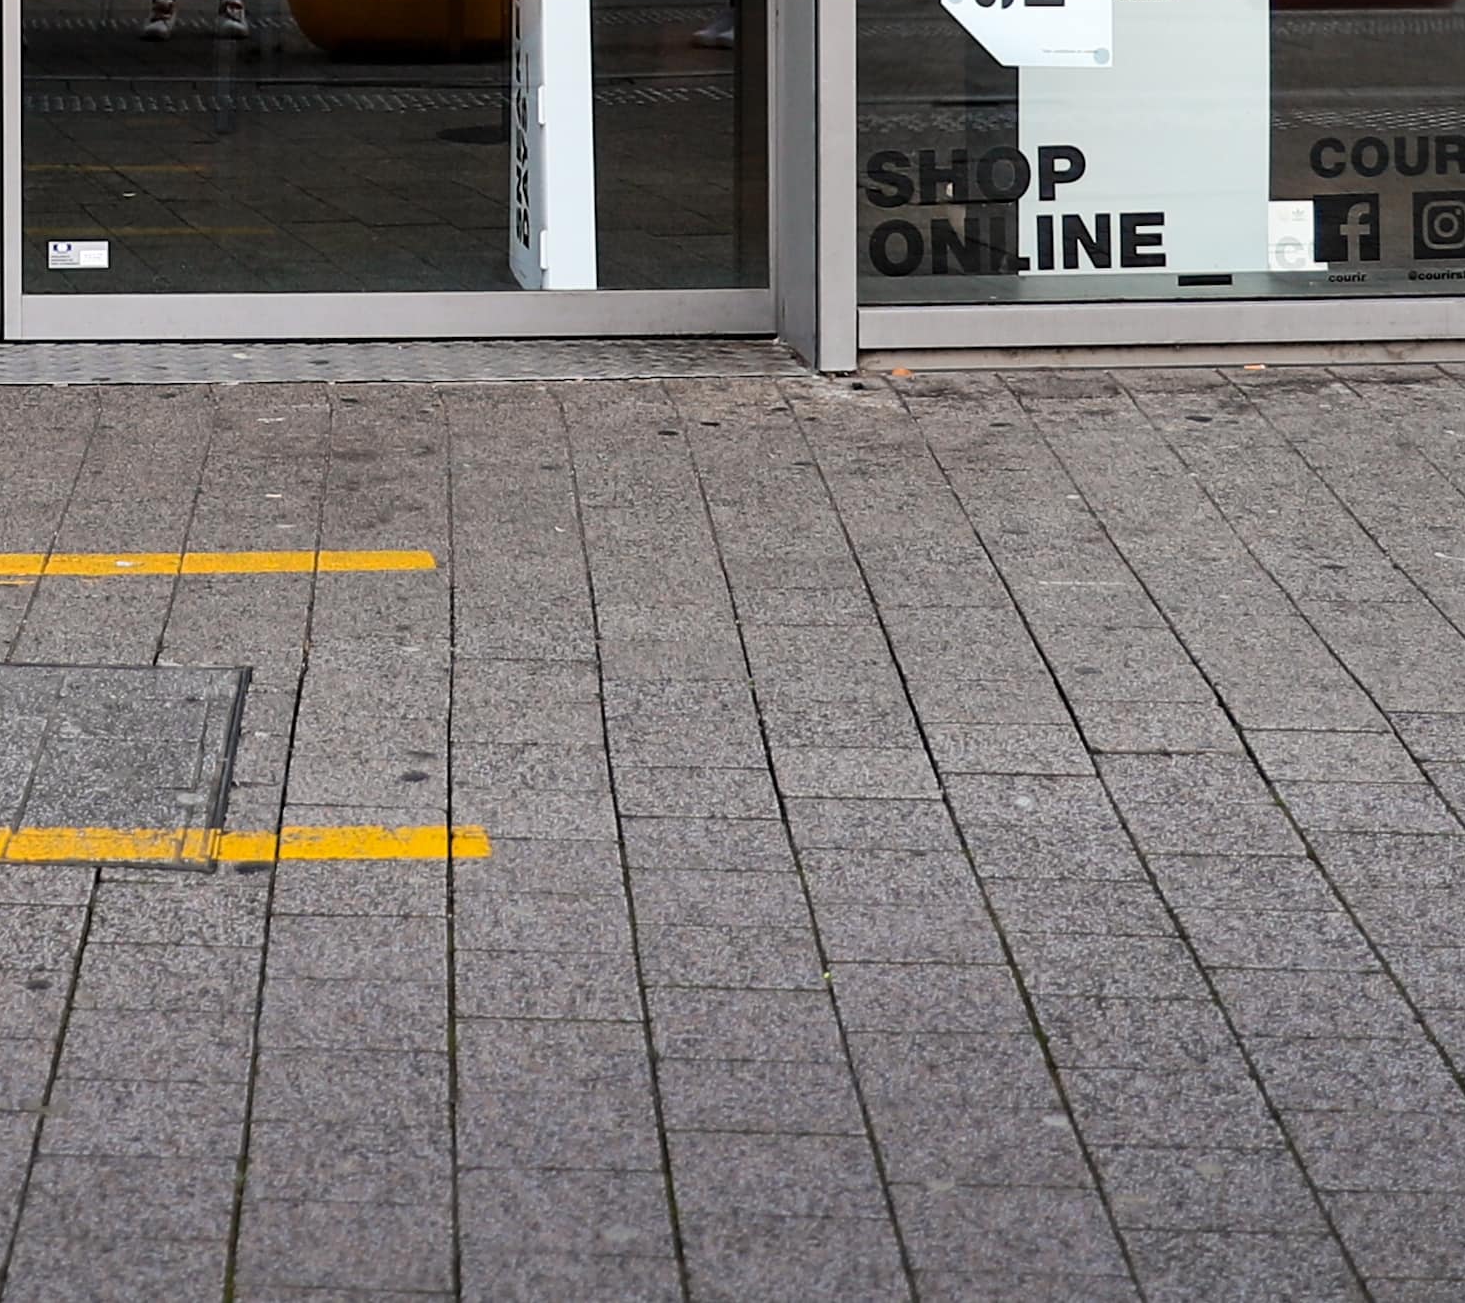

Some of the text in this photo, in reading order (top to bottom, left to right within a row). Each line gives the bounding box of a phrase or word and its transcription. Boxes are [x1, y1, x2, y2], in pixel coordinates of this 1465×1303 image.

[866, 144, 1086, 208] SHOP
[869, 211, 1167, 277] ONLINE
[1328, 271, 1366, 284] courir
